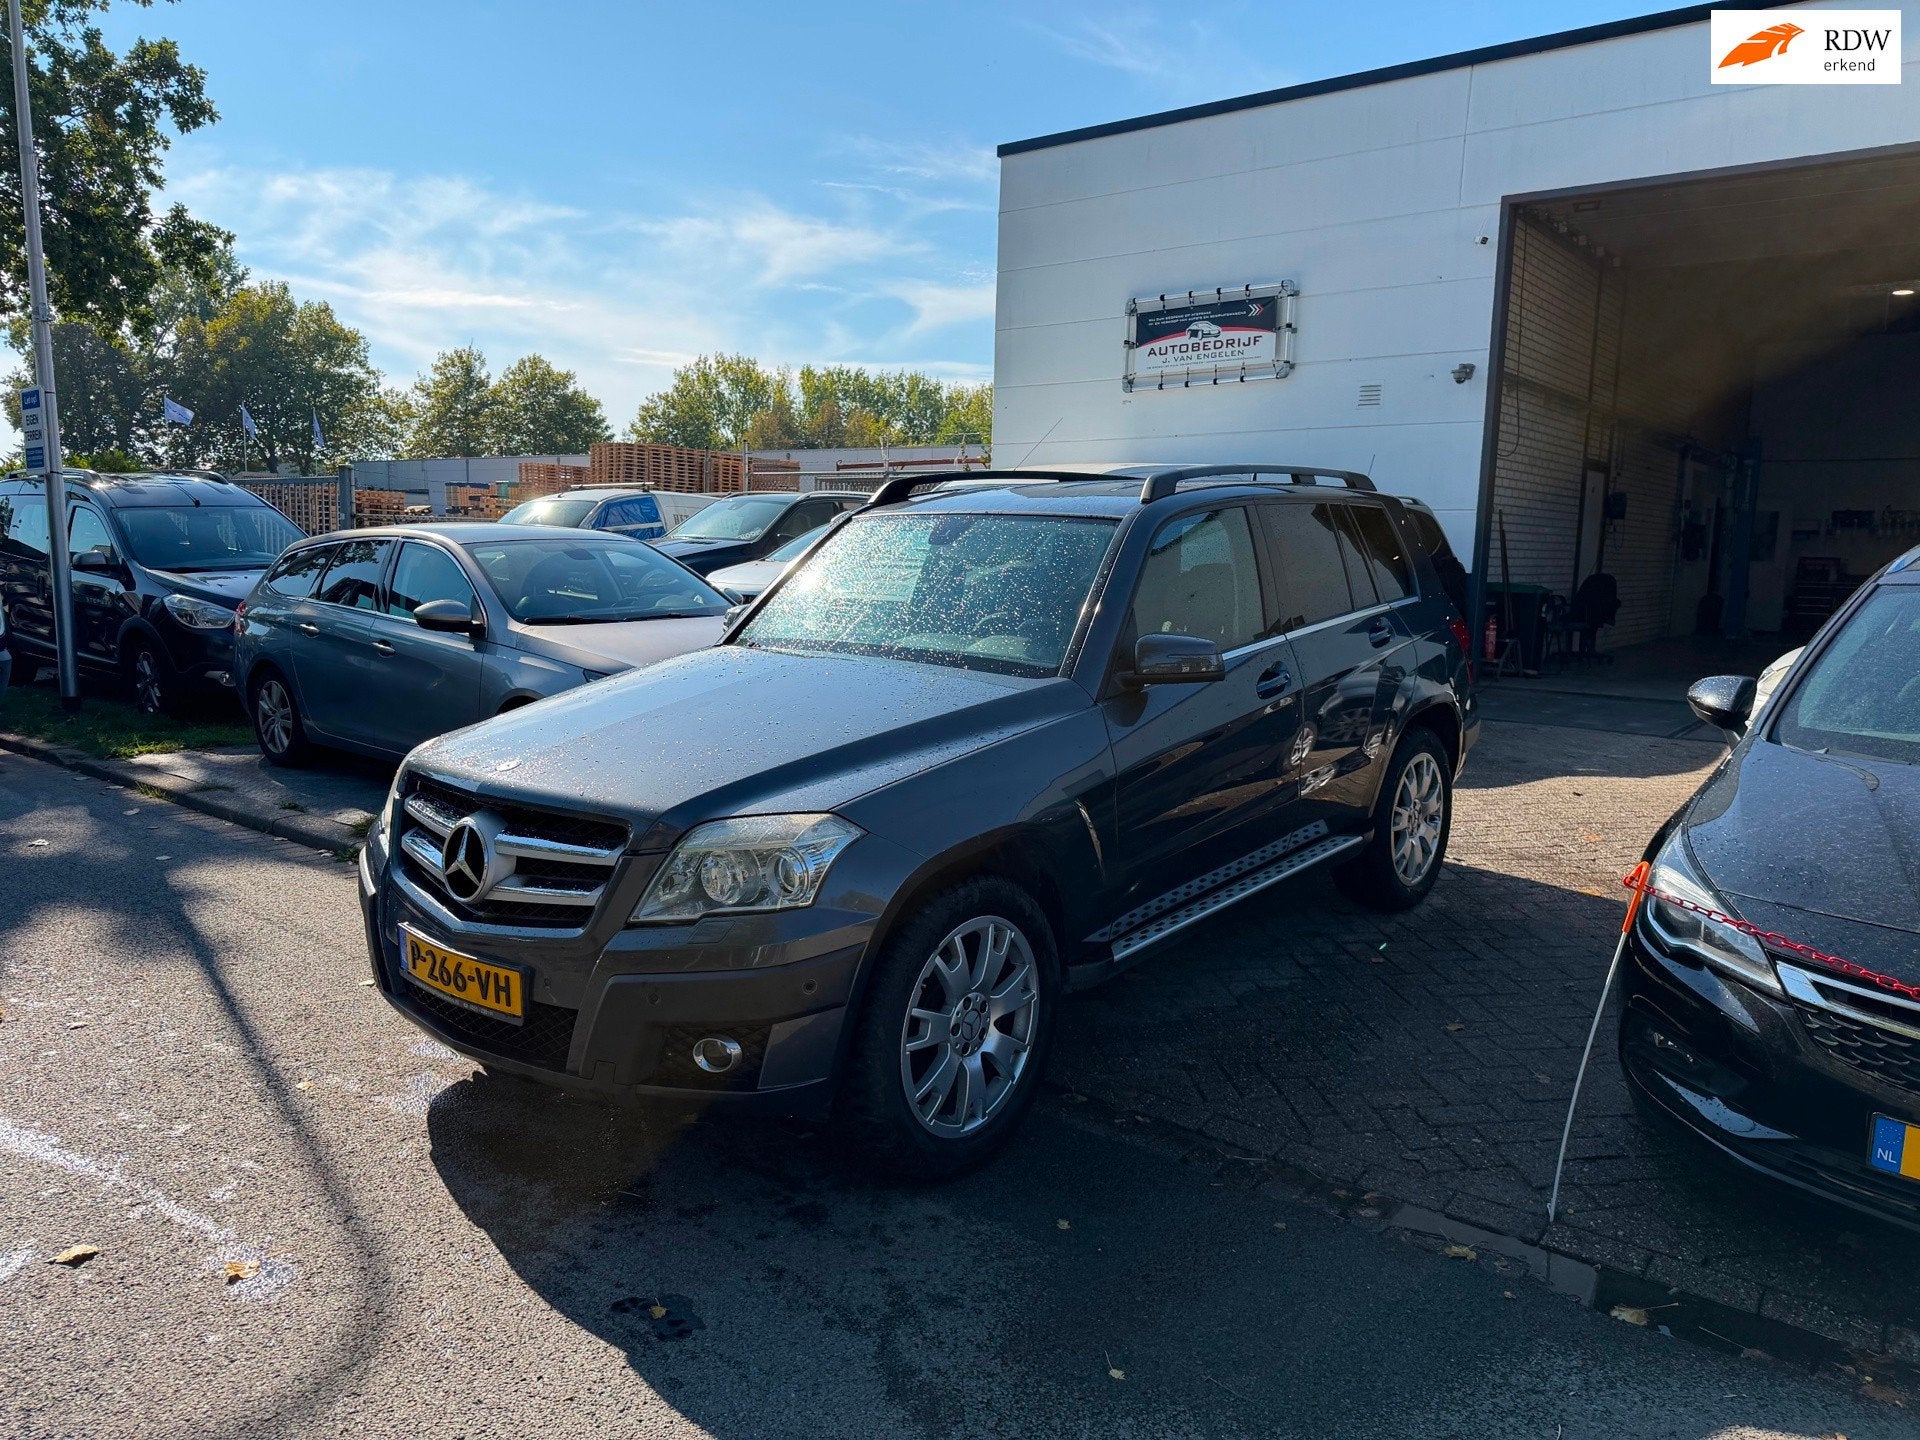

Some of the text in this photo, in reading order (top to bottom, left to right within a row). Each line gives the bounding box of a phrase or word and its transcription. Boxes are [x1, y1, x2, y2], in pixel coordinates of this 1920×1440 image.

[1147, 335, 1263, 357] AUTOBEDRIJF
[1174, 354, 1193, 363] VAN
[1196, 349, 1245, 361] ENGELEN
[409, 939, 512, 1008] P-266-VH
[1877, 1147, 1897, 1164] NL
